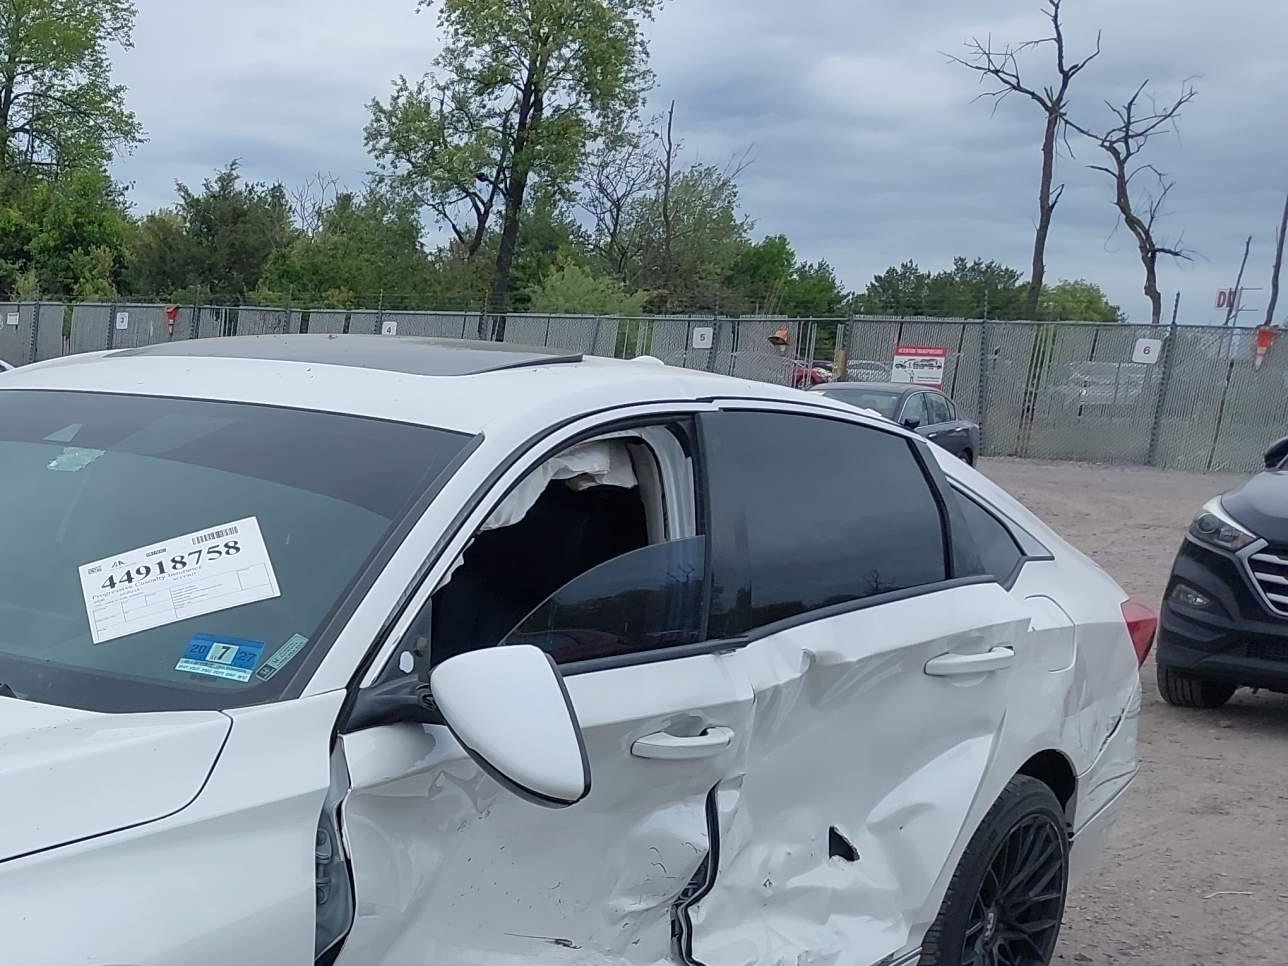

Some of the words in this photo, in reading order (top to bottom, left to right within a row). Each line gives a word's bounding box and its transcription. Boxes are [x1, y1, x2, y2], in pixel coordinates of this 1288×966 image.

[699, 333, 706, 341] 5
[1143, 345, 1151, 355] 6
[101, 540, 241, 590] 44918758
[217, 645, 231, 661] 7
